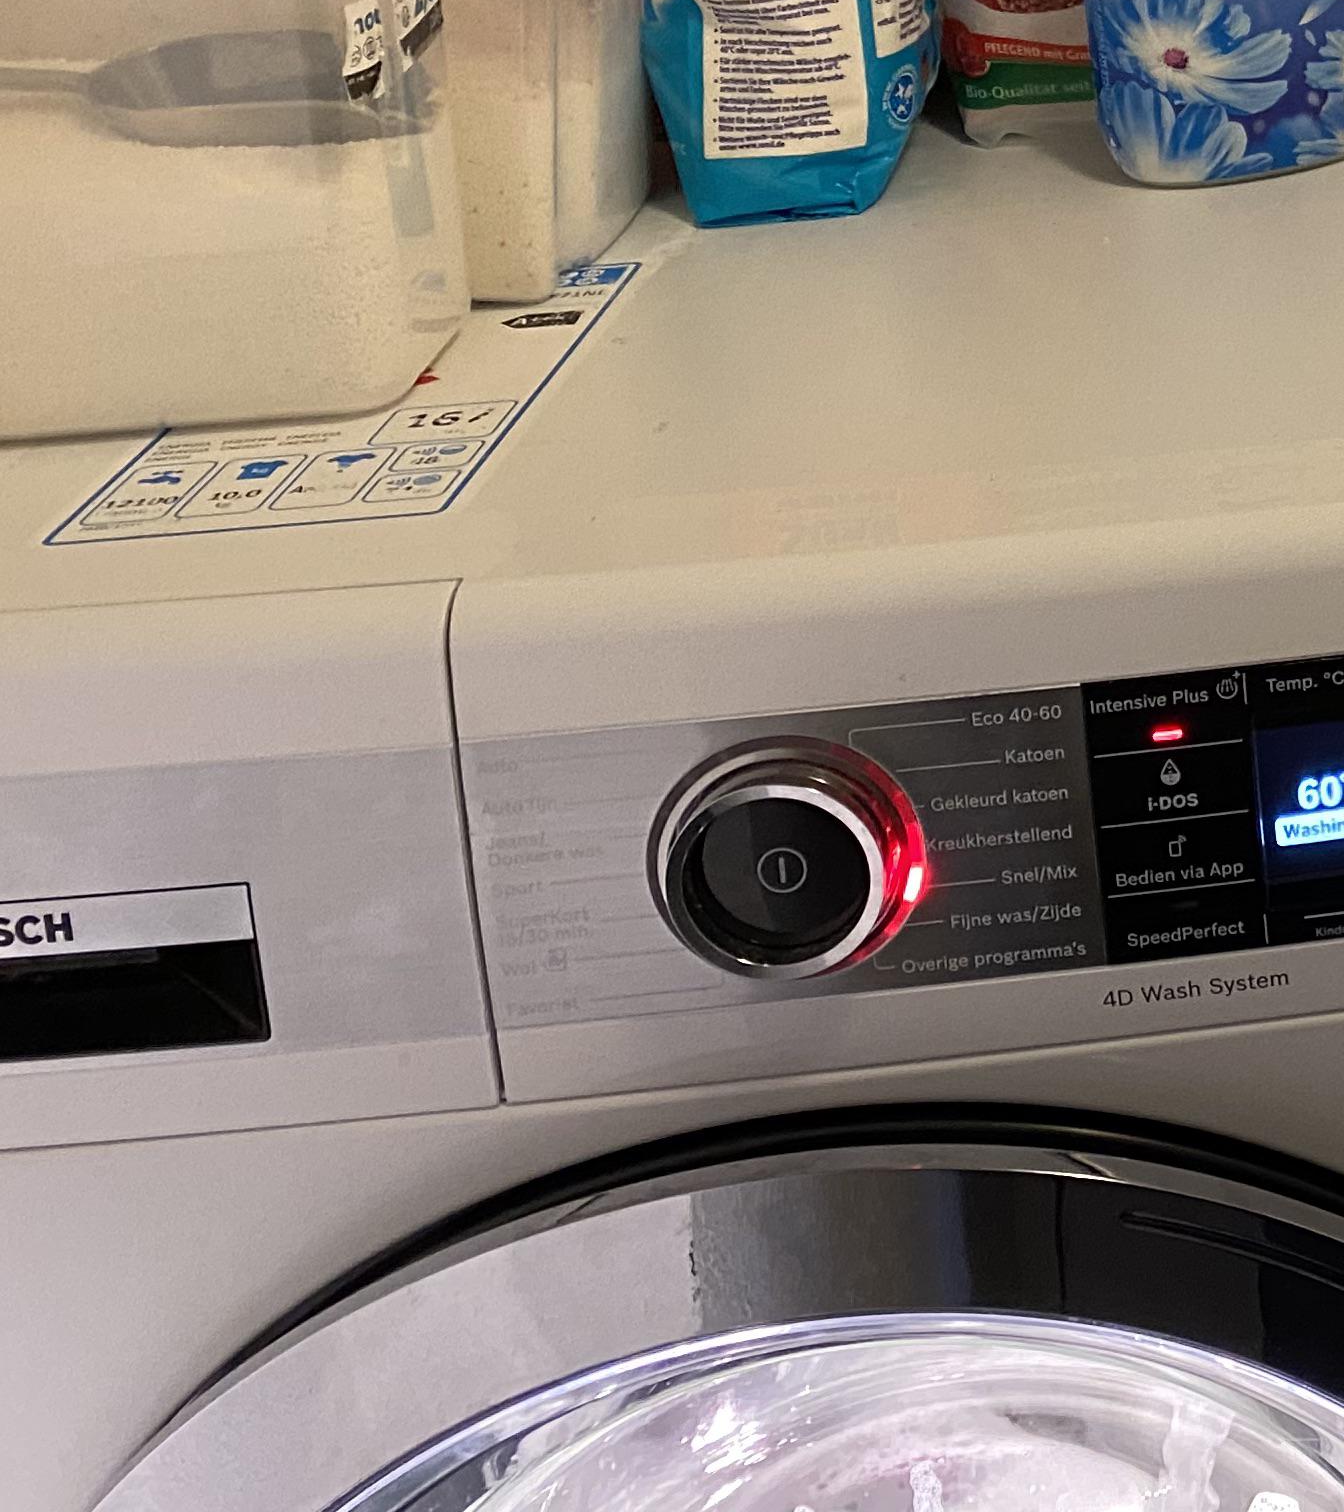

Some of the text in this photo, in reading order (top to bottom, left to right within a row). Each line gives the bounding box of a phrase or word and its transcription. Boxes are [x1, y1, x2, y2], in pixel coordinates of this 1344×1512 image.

[1266, 674, 1319, 696] Temp.
[1090, 689, 1209, 716] Intensive Plus
[971, 705, 1062, 727] Eco 40-60
[1004, 747, 1065, 765] Katoen
[930, 787, 1069, 812] Gekleurd katoen
[1148, 793, 1199, 812] i-DOS
[926, 825, 1073, 853] Kreukherstellend
[1001, 865, 1078, 885] Snel/Mix
[1116, 862, 1244, 887] Bedien via App
[950, 902, 1082, 931] Fijne was/Zijde
[1127, 920, 1245, 950] SpeedPerfect
[902, 942, 1087, 977] Overige programma's
[1102, 970, 1290, 1009] 4D Wash System
